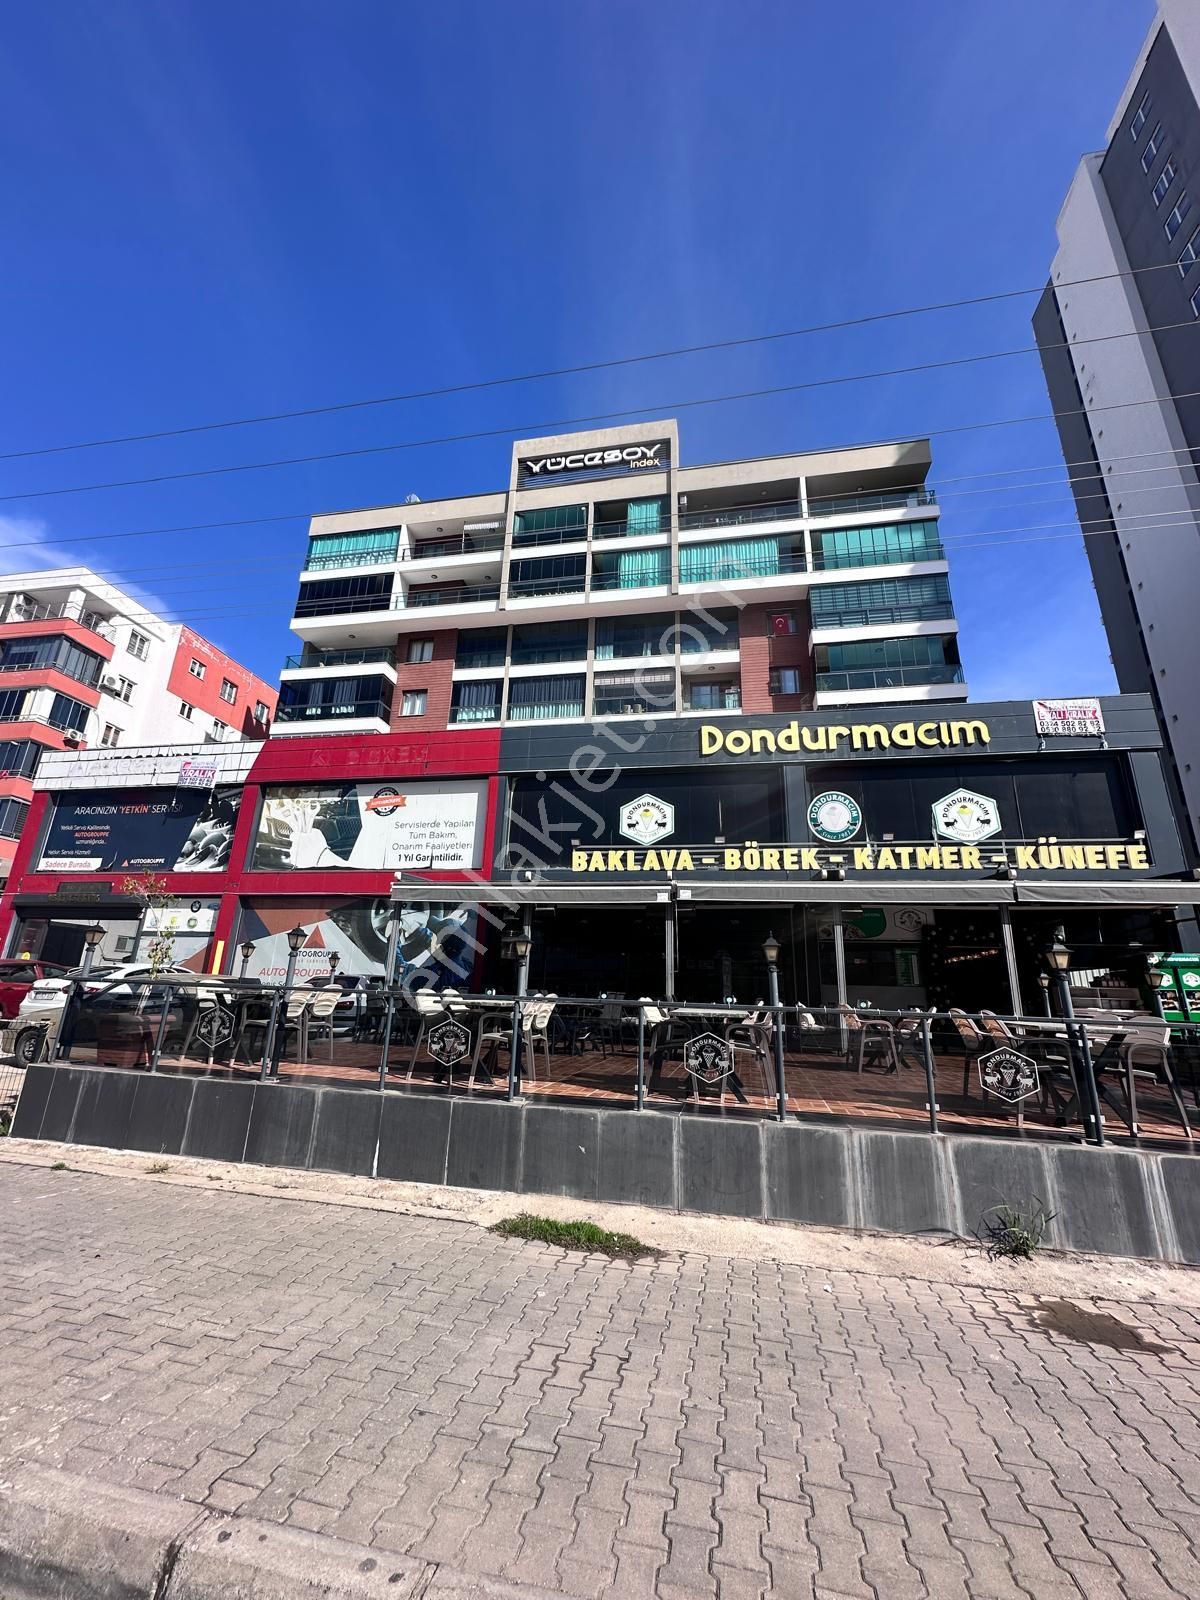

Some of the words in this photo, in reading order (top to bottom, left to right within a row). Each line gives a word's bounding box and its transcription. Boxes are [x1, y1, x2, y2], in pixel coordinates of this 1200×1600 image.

[394, 821, 441, 829] Servislerde
[409, 831, 427, 840] Tüm
[572, 850, 695, 872] BAKLAVA
[724, 841, 820, 871] BÖREK
[854, 846, 982, 870] KATMER
[1015, 837, 1149, 870] KÜNEFE
